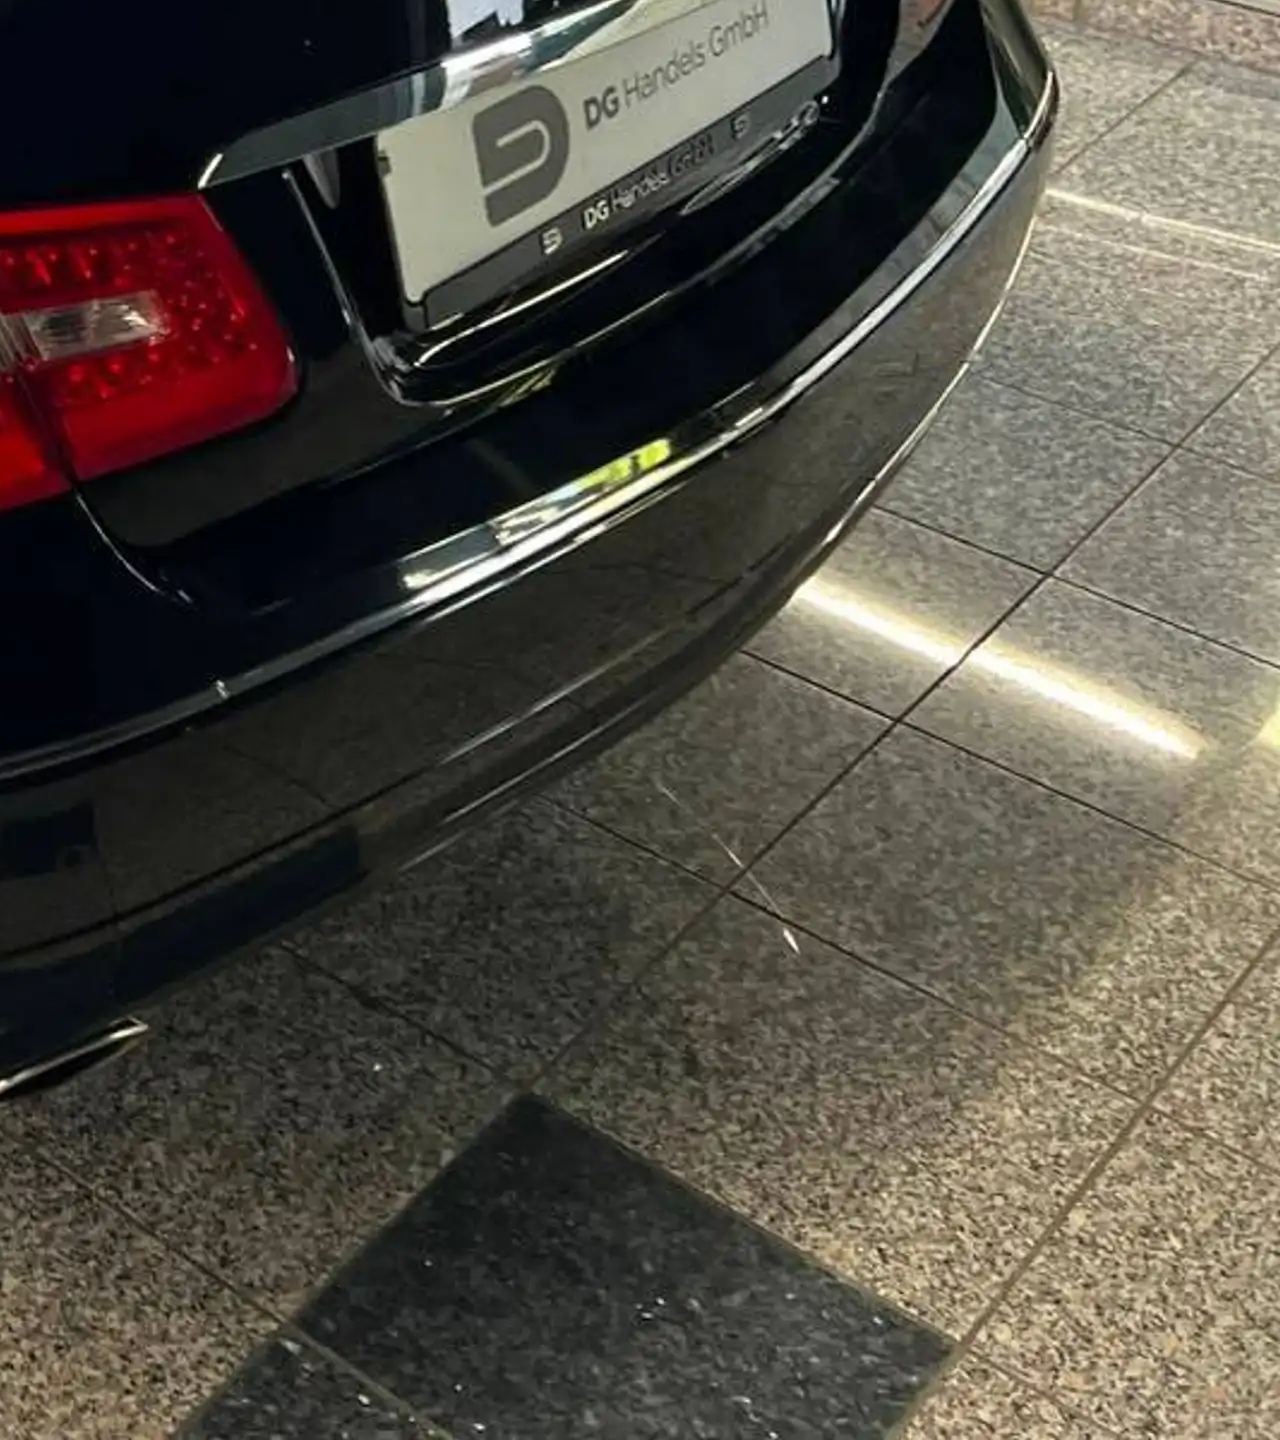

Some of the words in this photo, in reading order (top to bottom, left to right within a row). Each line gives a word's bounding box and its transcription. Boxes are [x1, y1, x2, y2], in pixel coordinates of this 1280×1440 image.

[583, 86, 620, 130] DG
[622, 42, 706, 109] Handels
[583, 200, 610, 229] DG
